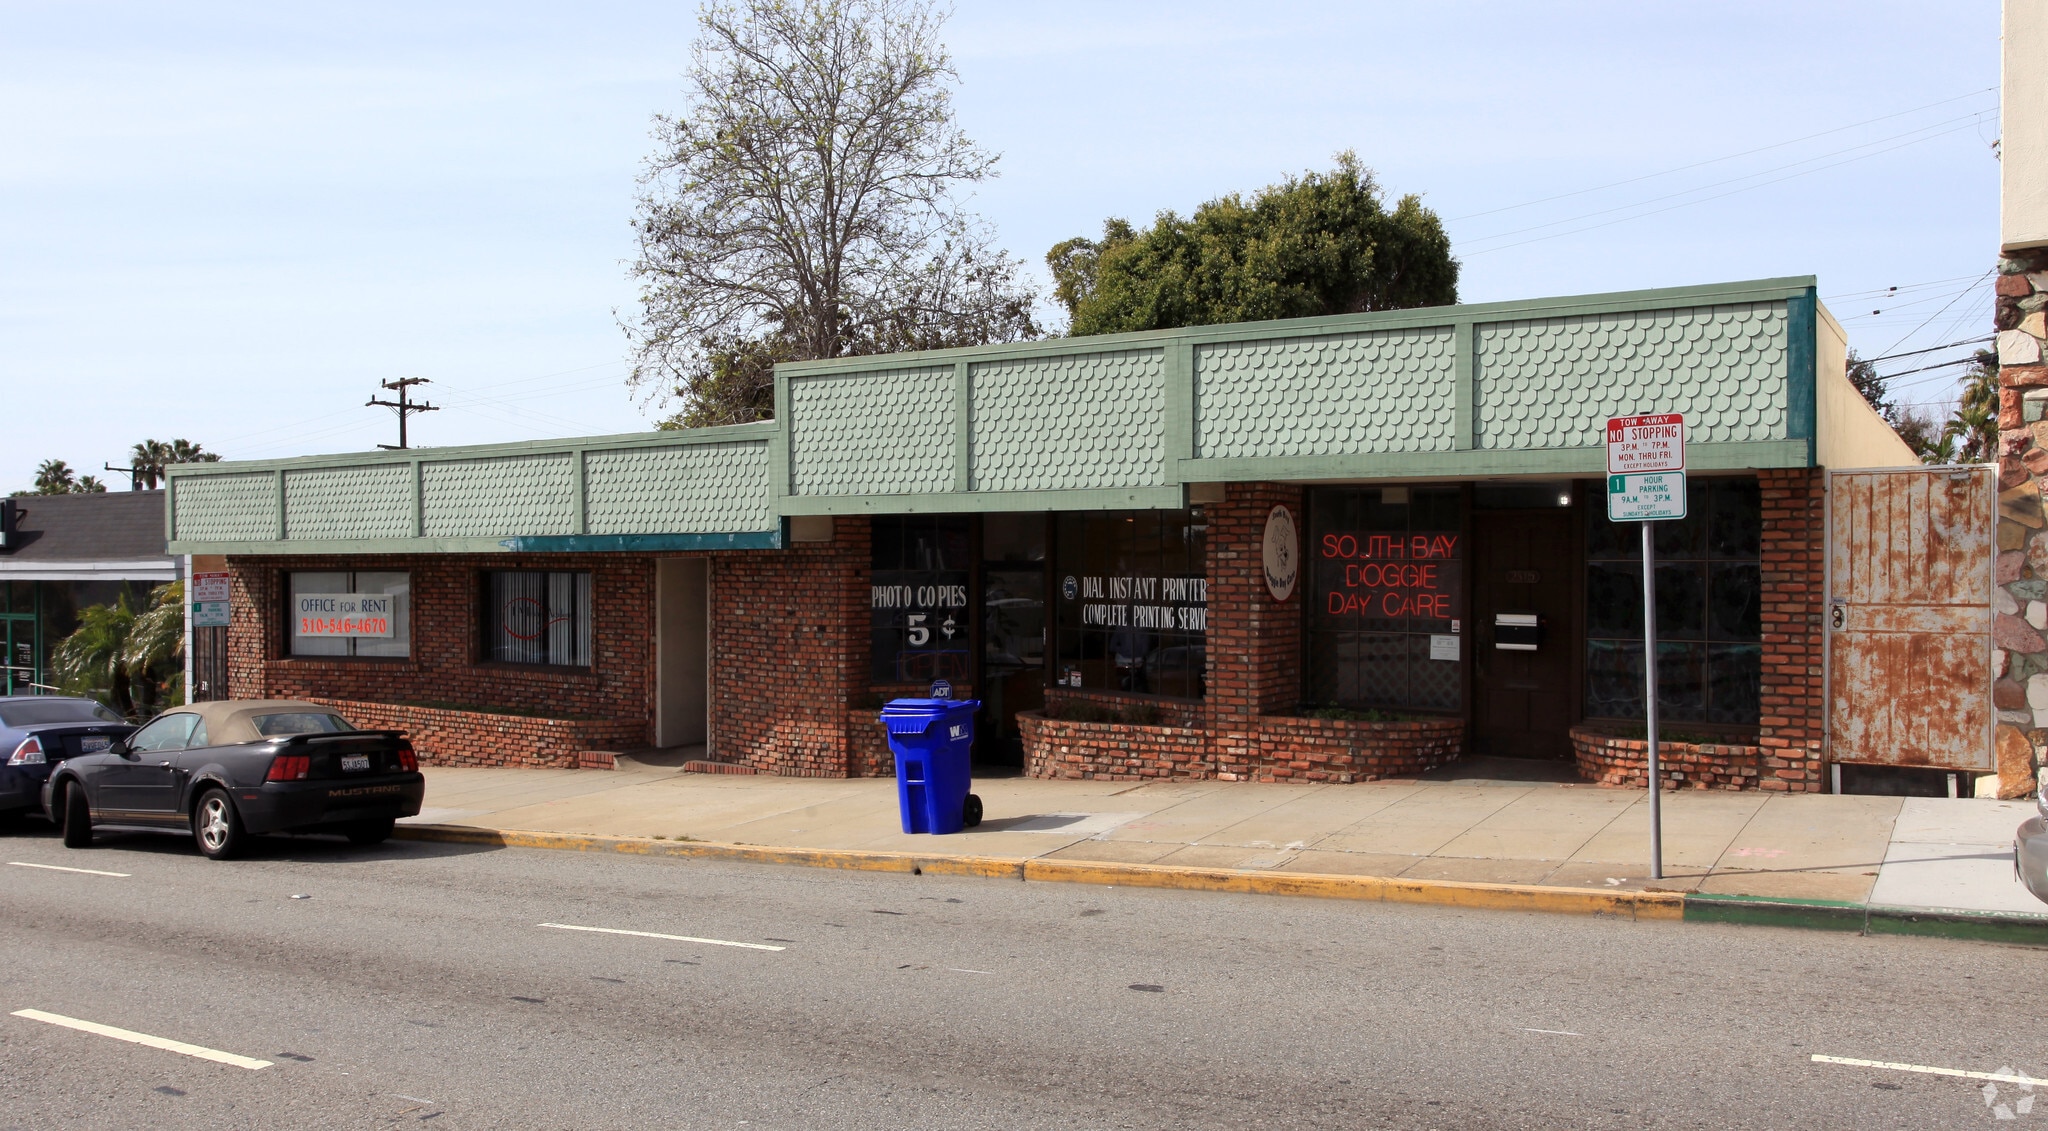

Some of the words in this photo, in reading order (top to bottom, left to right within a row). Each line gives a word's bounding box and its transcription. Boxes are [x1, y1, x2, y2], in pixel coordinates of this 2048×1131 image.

[1620, 418, 1638, 427] TOW
[1645, 416, 1669, 425] AWAY
[1610, 429, 1622, 442] NO
[1632, 425, 1677, 440] STOPPING
[1618, 453, 1635, 462] MON.
[1639, 451, 1657, 461] THRU
[1659, 451, 1673, 460] FRI.
[1643, 461, 1668, 469] HOLIDAYS
[1616, 478, 1620, 491] 1
[1644, 476, 1663, 484] HOUR
[1639, 485, 1668, 493] PARKING
[1322, 534, 1404, 558] SOUTH
[1412, 536, 1458, 559] BAY
[1346, 563, 1437, 589] DOGGIE
[1083, 576, 1104, 598] DIAL
[1109, 577, 1157, 599] INSTANT
[872, 585, 912, 608] PHOTO
[917, 585, 967, 607] COPIES
[301, 598, 335, 612] OFFICE
[340, 602, 356, 612] FOR
[361, 599, 387, 612] RENT
[1328, 592, 1372, 617] DAY
[1382, 592, 1450, 618] CARE
[1083, 603, 1128, 627] COMPLETE
[1133, 605, 1175, 628] PRINTING
[301, 617, 387, 634] 310-546-4670
[932, 687, 949, 698] ADT
[328, 785, 401, 798] MUSTANG
